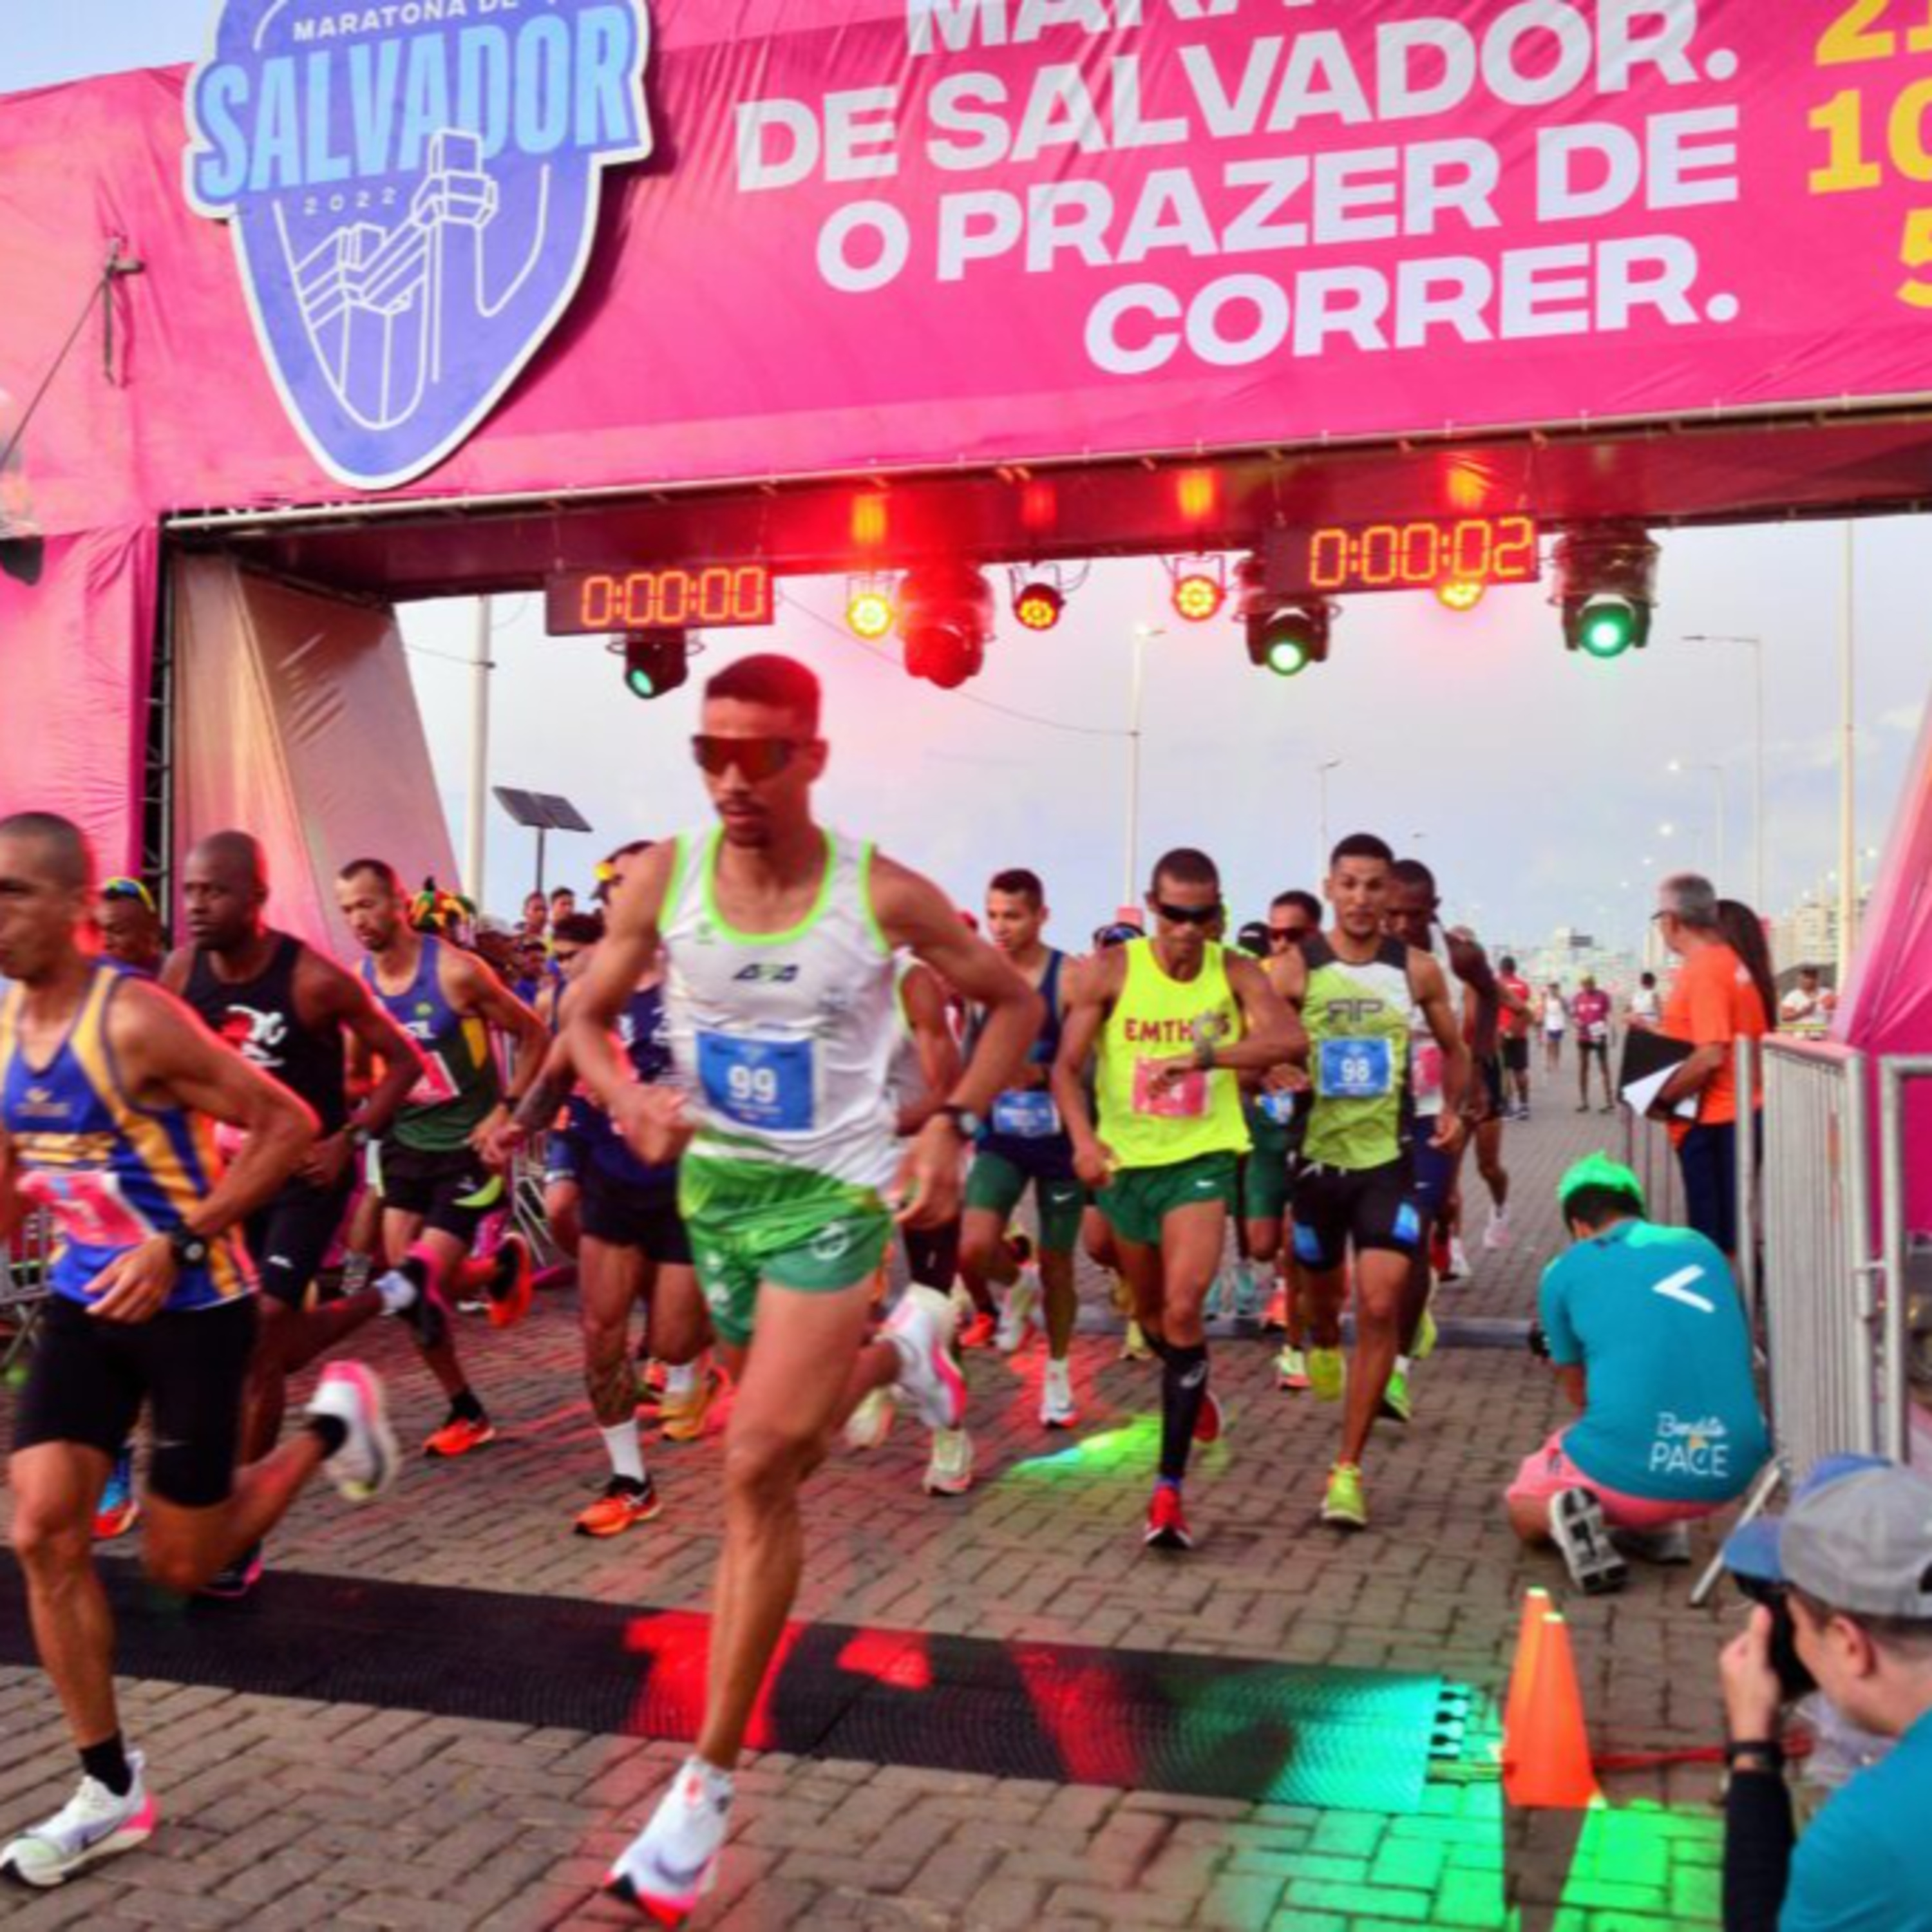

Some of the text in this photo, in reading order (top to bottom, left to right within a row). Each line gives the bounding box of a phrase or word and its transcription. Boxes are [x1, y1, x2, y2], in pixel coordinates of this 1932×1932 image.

[293, 2, 467, 41] MARATONA
[198, 5, 631, 198] SALVADOR
[735, 0, 1738, 191] DE SALVADOR.
[304, 187, 396, 216] 2022
[817, 104, 1739, 292] O PRAZER DE
[1084, 234, 1739, 374] CORRER.
[1310, 516, 1533, 587] 0:00:02
[582, 567, 765, 627] 0:00:00
[728, 1065, 778, 1104] 99
[1649, 1441, 1730, 1478] PACE
